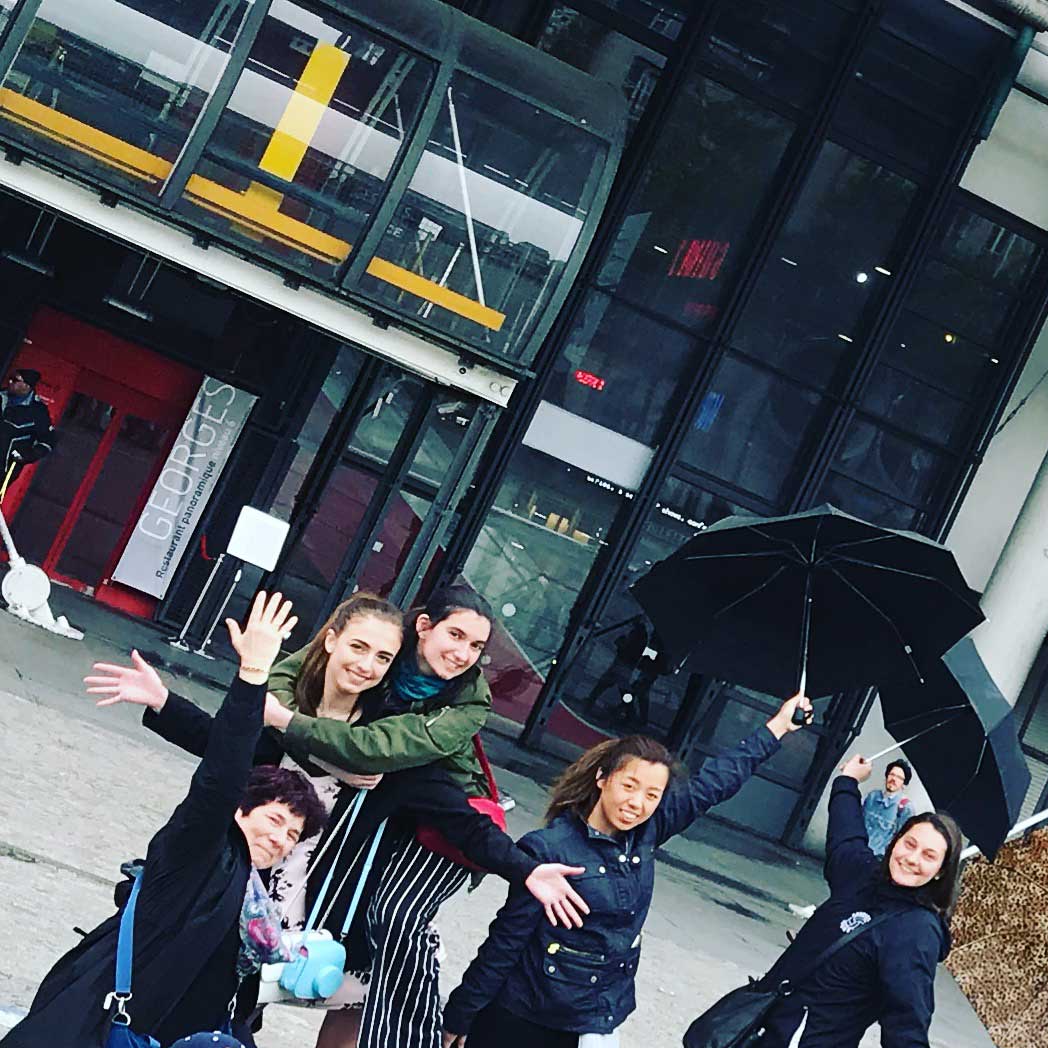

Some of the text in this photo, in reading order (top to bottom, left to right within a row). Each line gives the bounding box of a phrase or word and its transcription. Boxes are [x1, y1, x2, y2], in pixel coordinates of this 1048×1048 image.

[138, 379, 236, 541] GEORGES
[155, 524, 186, 579] Restaurant
[183, 460, 217, 525] panoramique
